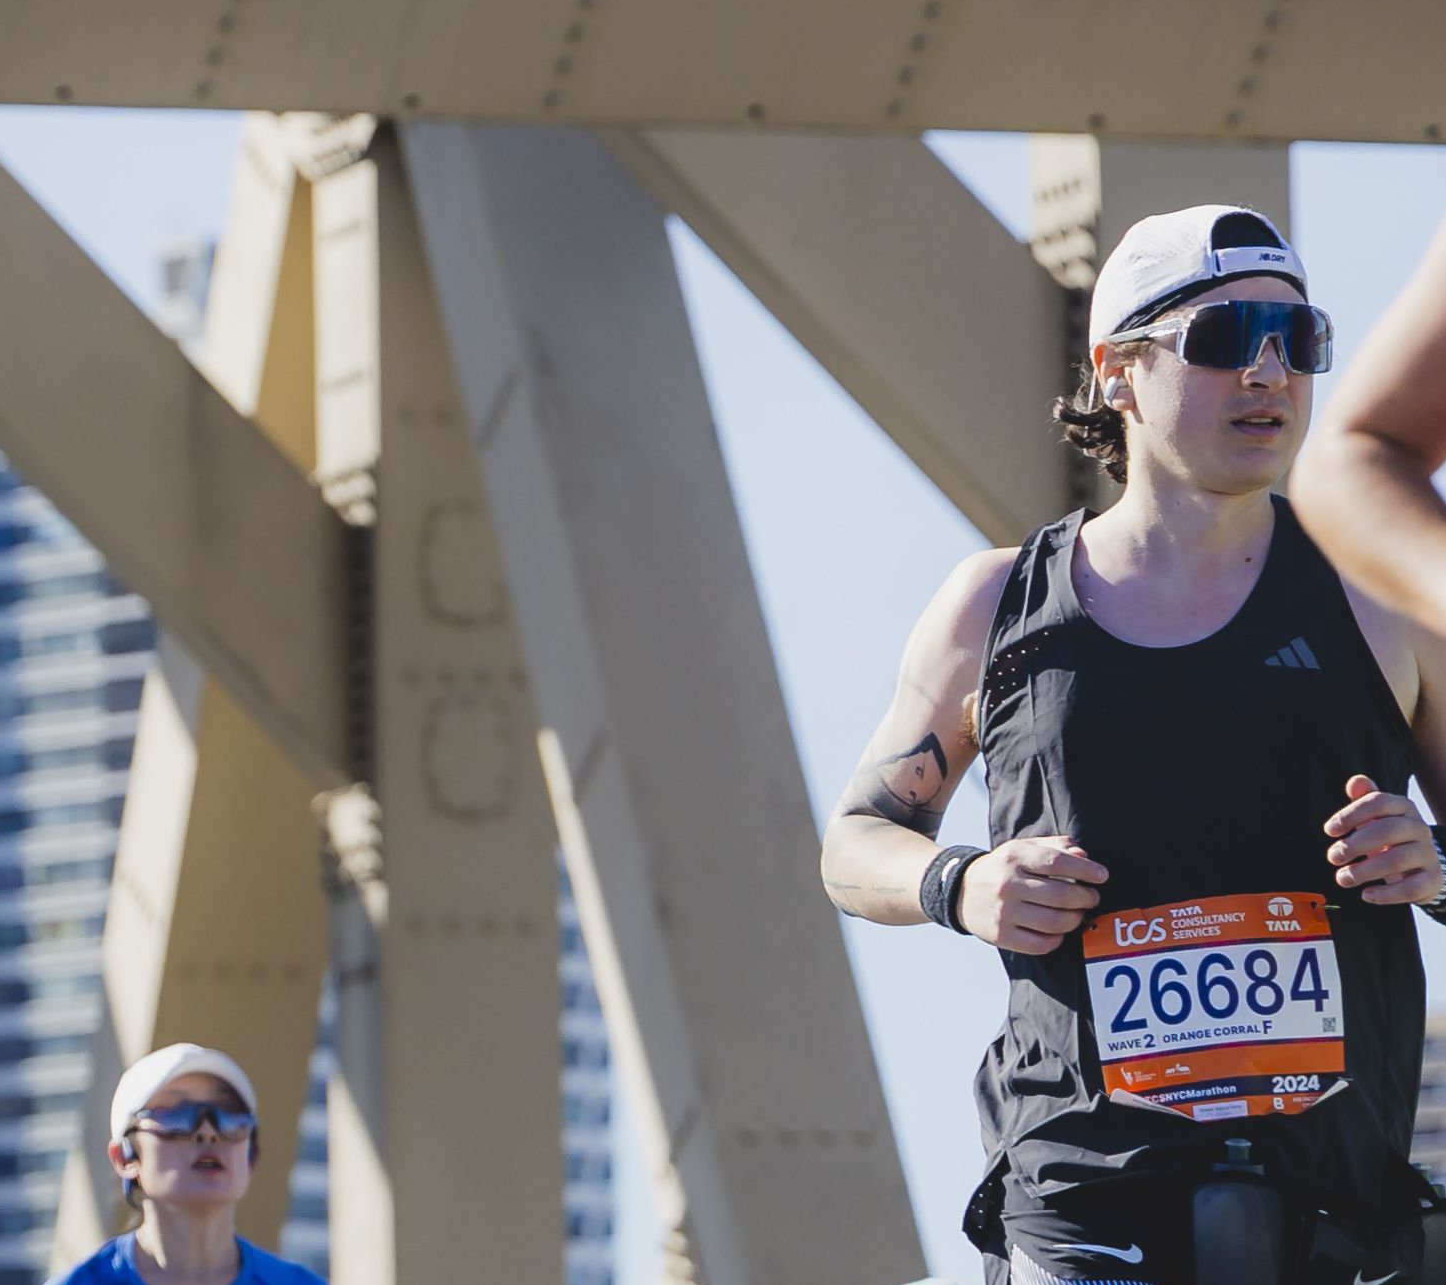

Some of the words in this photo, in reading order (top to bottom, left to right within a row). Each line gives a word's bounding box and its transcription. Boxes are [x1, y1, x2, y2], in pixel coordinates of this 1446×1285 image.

[1170, 905, 1202, 918] TATA
[1171, 912, 1246, 929] CONSULTANCY
[1265, 920, 1301, 932] TATA
[1114, 917, 1166, 947] tcs
[1172, 926, 1222, 940] SERVICES
[1104, 948, 1329, 1034] 26684
[1108, 1039, 1142, 1052] WAVE
[1143, 1034, 1156, 1048] 2
[1162, 1029, 1212, 1044] ORANGE
[1214, 1024, 1261, 1037] CORRAL
[1262, 1020, 1273, 1034] F
[1272, 1075, 1320, 1093] 2024
[1273, 1097, 1285, 1110] B
